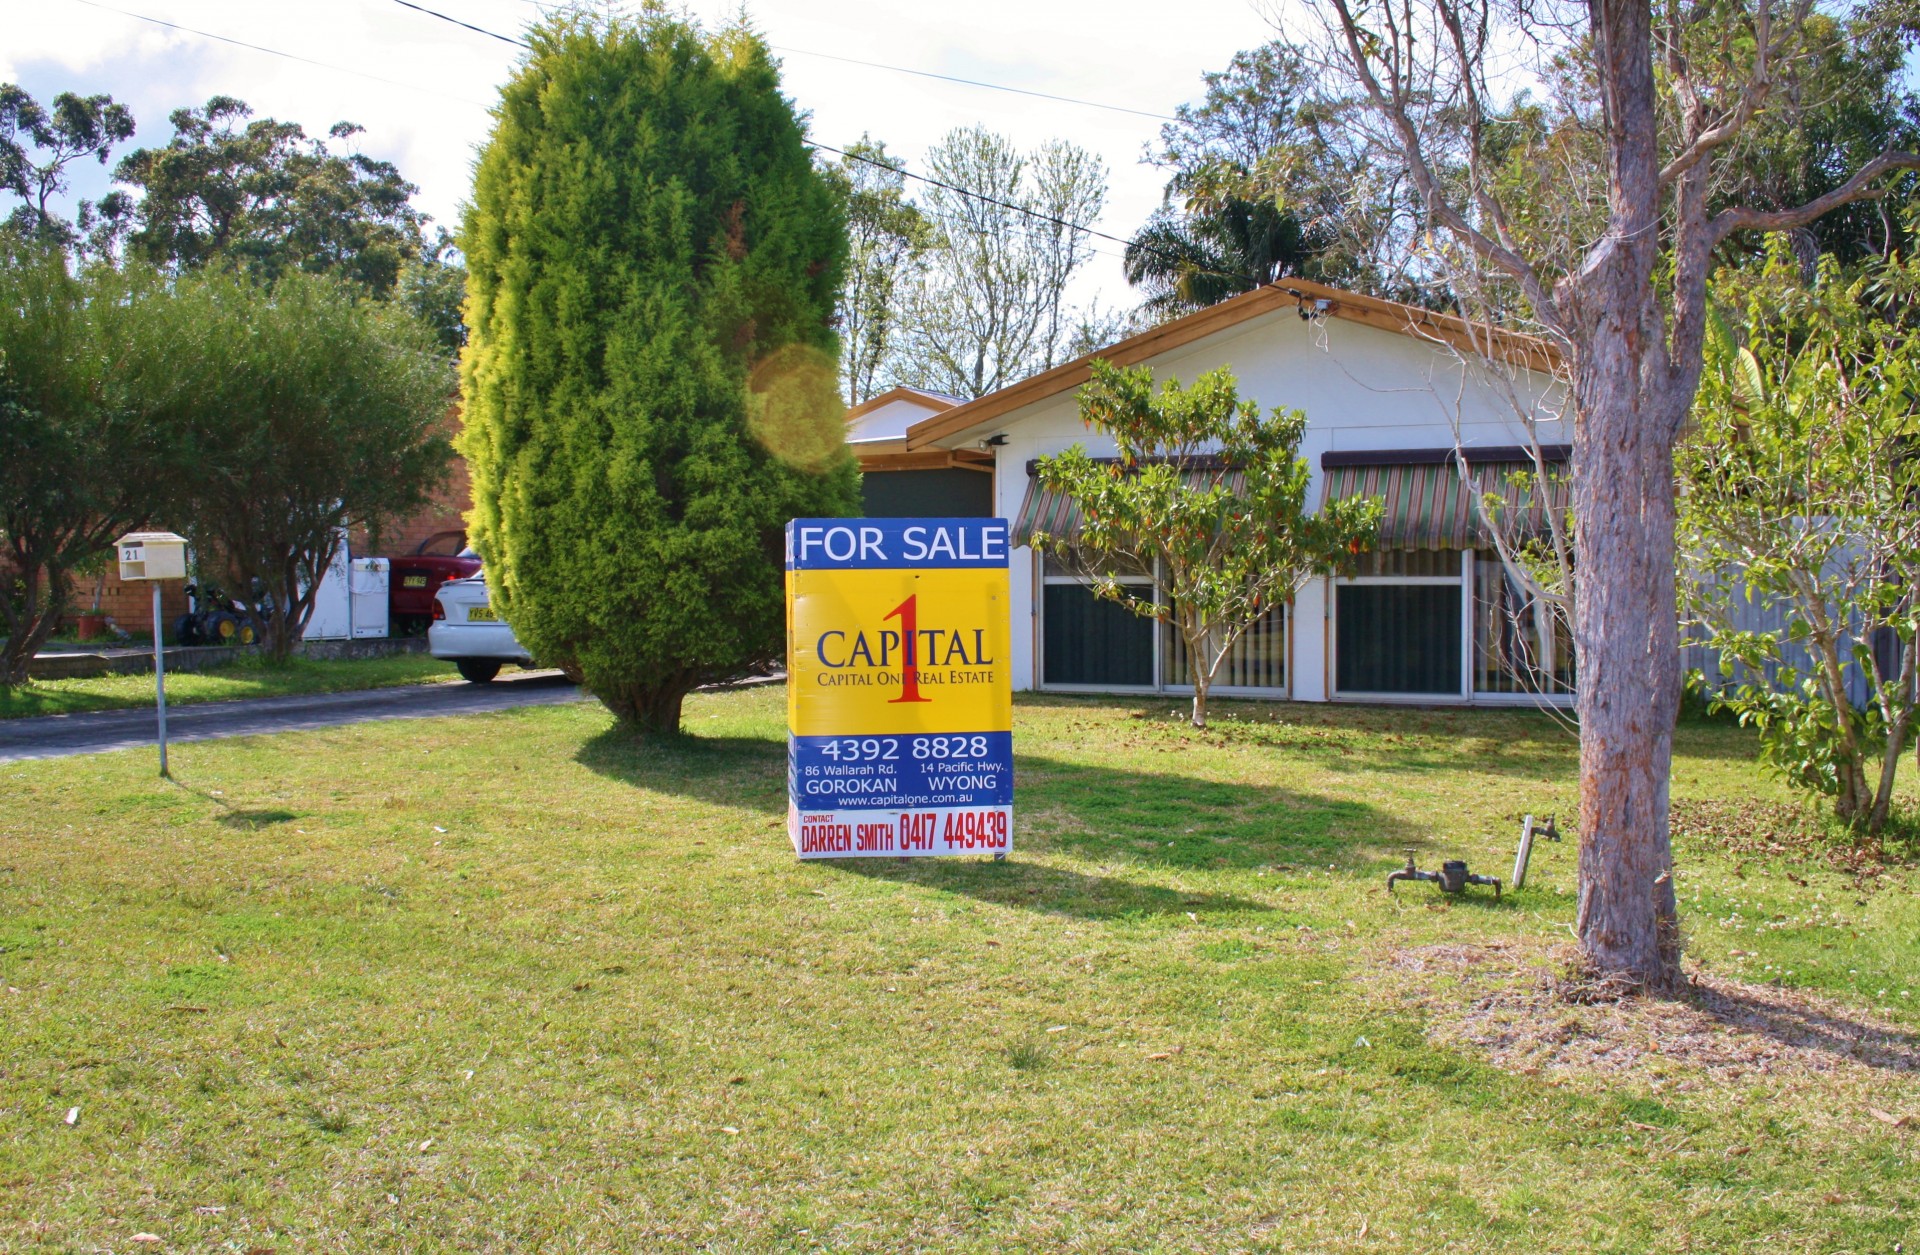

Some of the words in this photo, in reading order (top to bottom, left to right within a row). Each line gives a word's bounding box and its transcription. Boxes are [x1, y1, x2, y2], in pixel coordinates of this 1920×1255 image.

[800, 527, 888, 561] FOR
[903, 526, 1005, 561] SALE
[125, 549, 138, 561] 21
[817, 629, 994, 668] CAPITAL
[821, 739, 900, 761] 4392
[912, 735, 988, 759] 8828
[805, 766, 820, 776] 86
[823, 764, 874, 776] Wallarah
[878, 764, 897, 775] Rd.
[920, 763, 934, 773] 14
[938, 761, 973, 773] Pacific
[977, 761, 1004, 774] Hwy.
[806, 778, 897, 794] GOROKAN
[928, 775, 997, 791] WYONG
[838, 793, 973, 807] www.capitalone.com.au
[803, 814, 834, 823] CONTACT
[801, 824, 852, 853] DARREN
[856, 823, 894, 851] SMITH
[900, 813, 936, 850] 0417
[944, 811, 1007, 850] 449439
